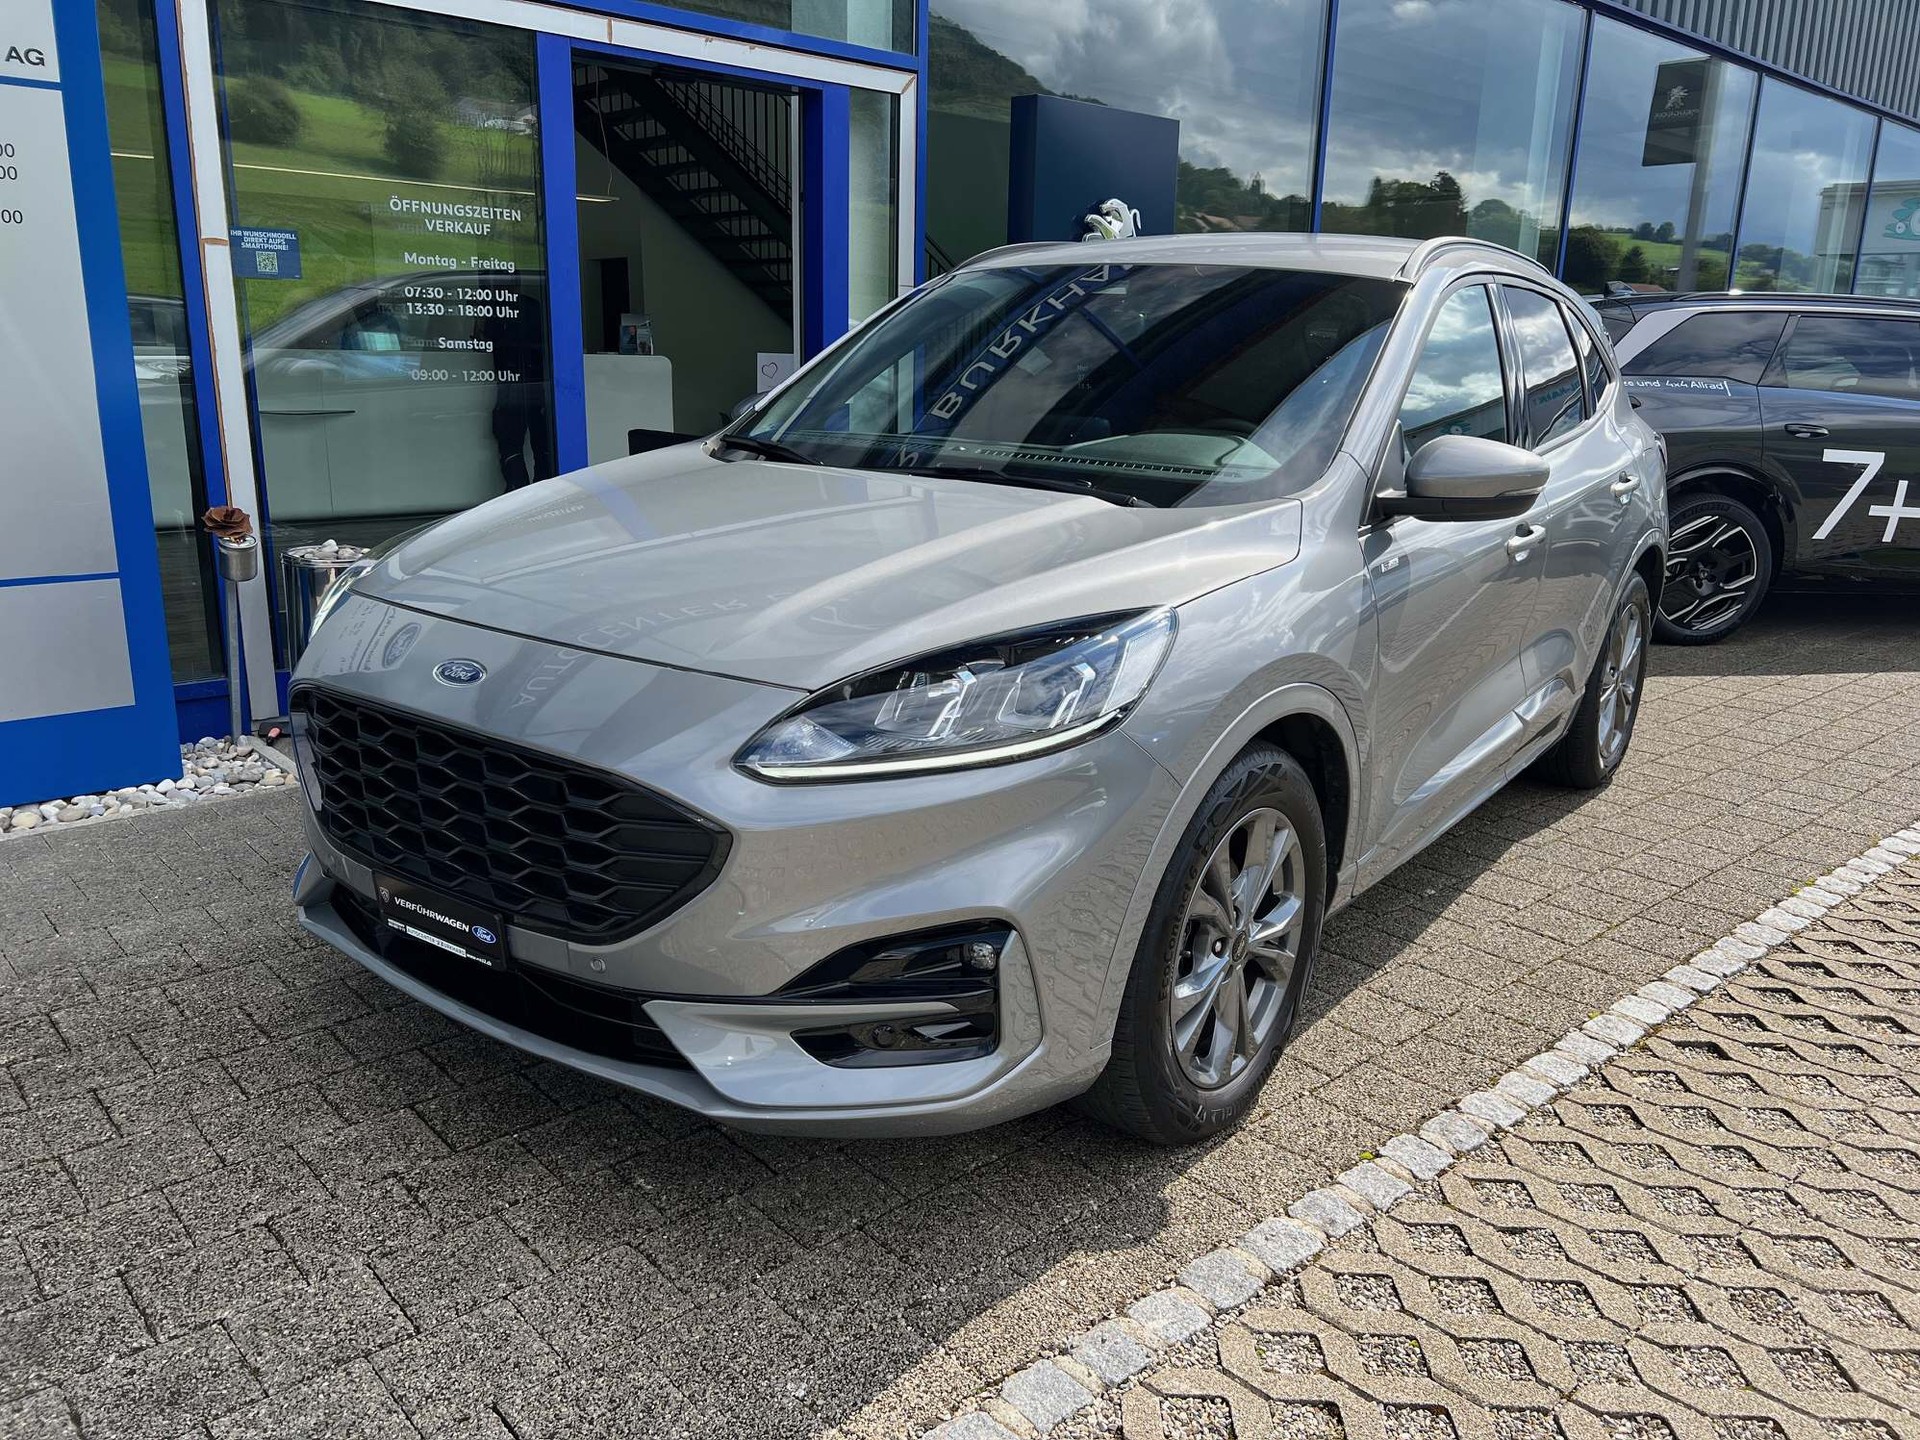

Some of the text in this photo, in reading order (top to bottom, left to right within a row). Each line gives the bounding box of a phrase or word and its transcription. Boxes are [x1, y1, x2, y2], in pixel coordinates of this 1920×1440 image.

[5, 45, 46, 67] AG
[0, 143, 15, 158] 0
[389, 195, 521, 221] ÖFFNUNGSZEITEN
[425, 218, 491, 235] VERKAUF
[404, 252, 457, 270] Montag
[470, 256, 516, 273] Freitag
[404, 286, 444, 299] 07:30
[457, 288, 492, 301] 12:00
[495, 290, 519, 302] Uhr
[407, 302, 444, 315] 13:30
[458, 304, 493, 317] 18:00
[496, 306, 520, 318] Uhr
[438, 337, 493, 352] Samstag
[411, 369, 448, 381] 09:00
[462, 370, 495, 382] 12:00
[498, 370, 521, 382] Uhr
[1665, 380, 1688, 388] 4x4
[394, 896, 469, 933] VERFÜHRWAGEN
